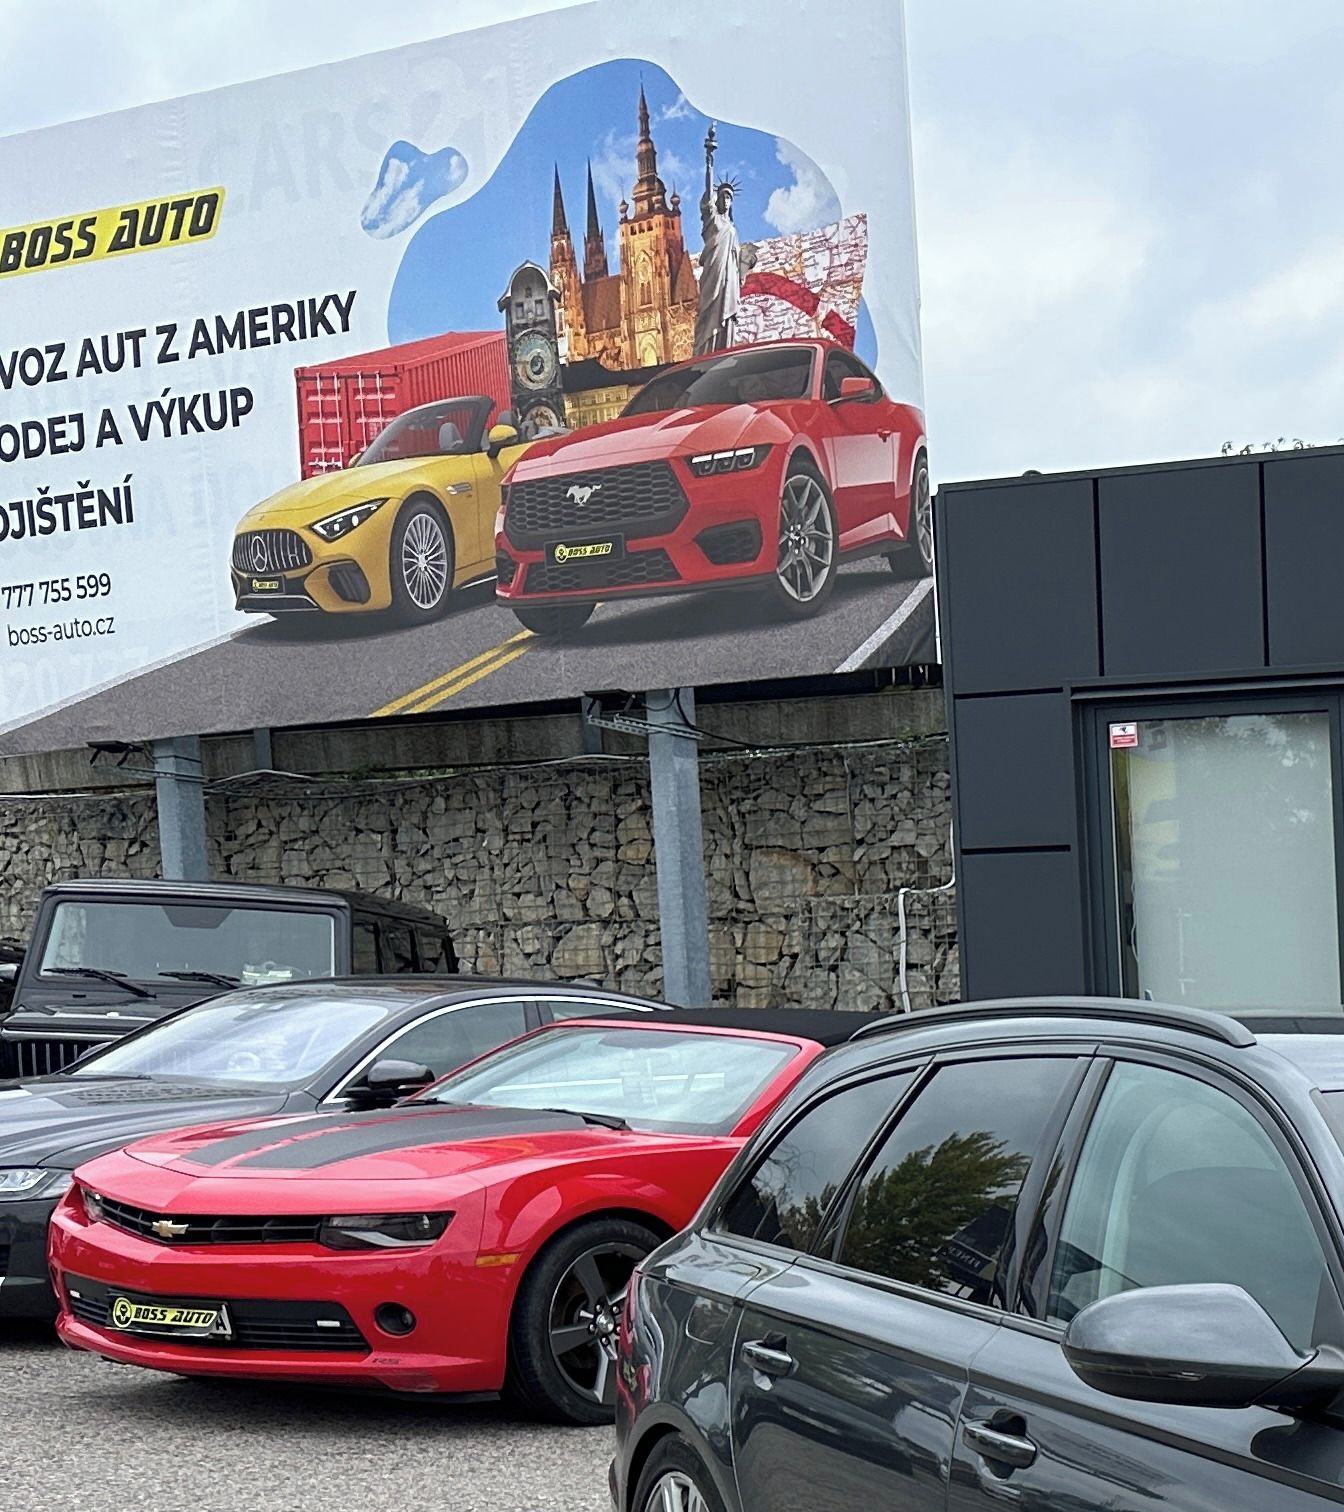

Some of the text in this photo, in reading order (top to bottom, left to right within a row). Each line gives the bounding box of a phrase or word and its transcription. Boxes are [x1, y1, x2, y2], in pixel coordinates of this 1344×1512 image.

[0, 192, 219, 273] BOSS AUTO
[75, 329, 147, 378] AUT
[155, 324, 180, 364] Z
[188, 290, 357, 359] AMERIKY
[96, 408, 123, 449] A
[128, 386, 254, 442] VÝKUP
[1, 572, 112, 610] 777 755 599
[7, 616, 116, 647] boss-auto.cz
[134, 1307, 214, 1324] BOSS AUTO
